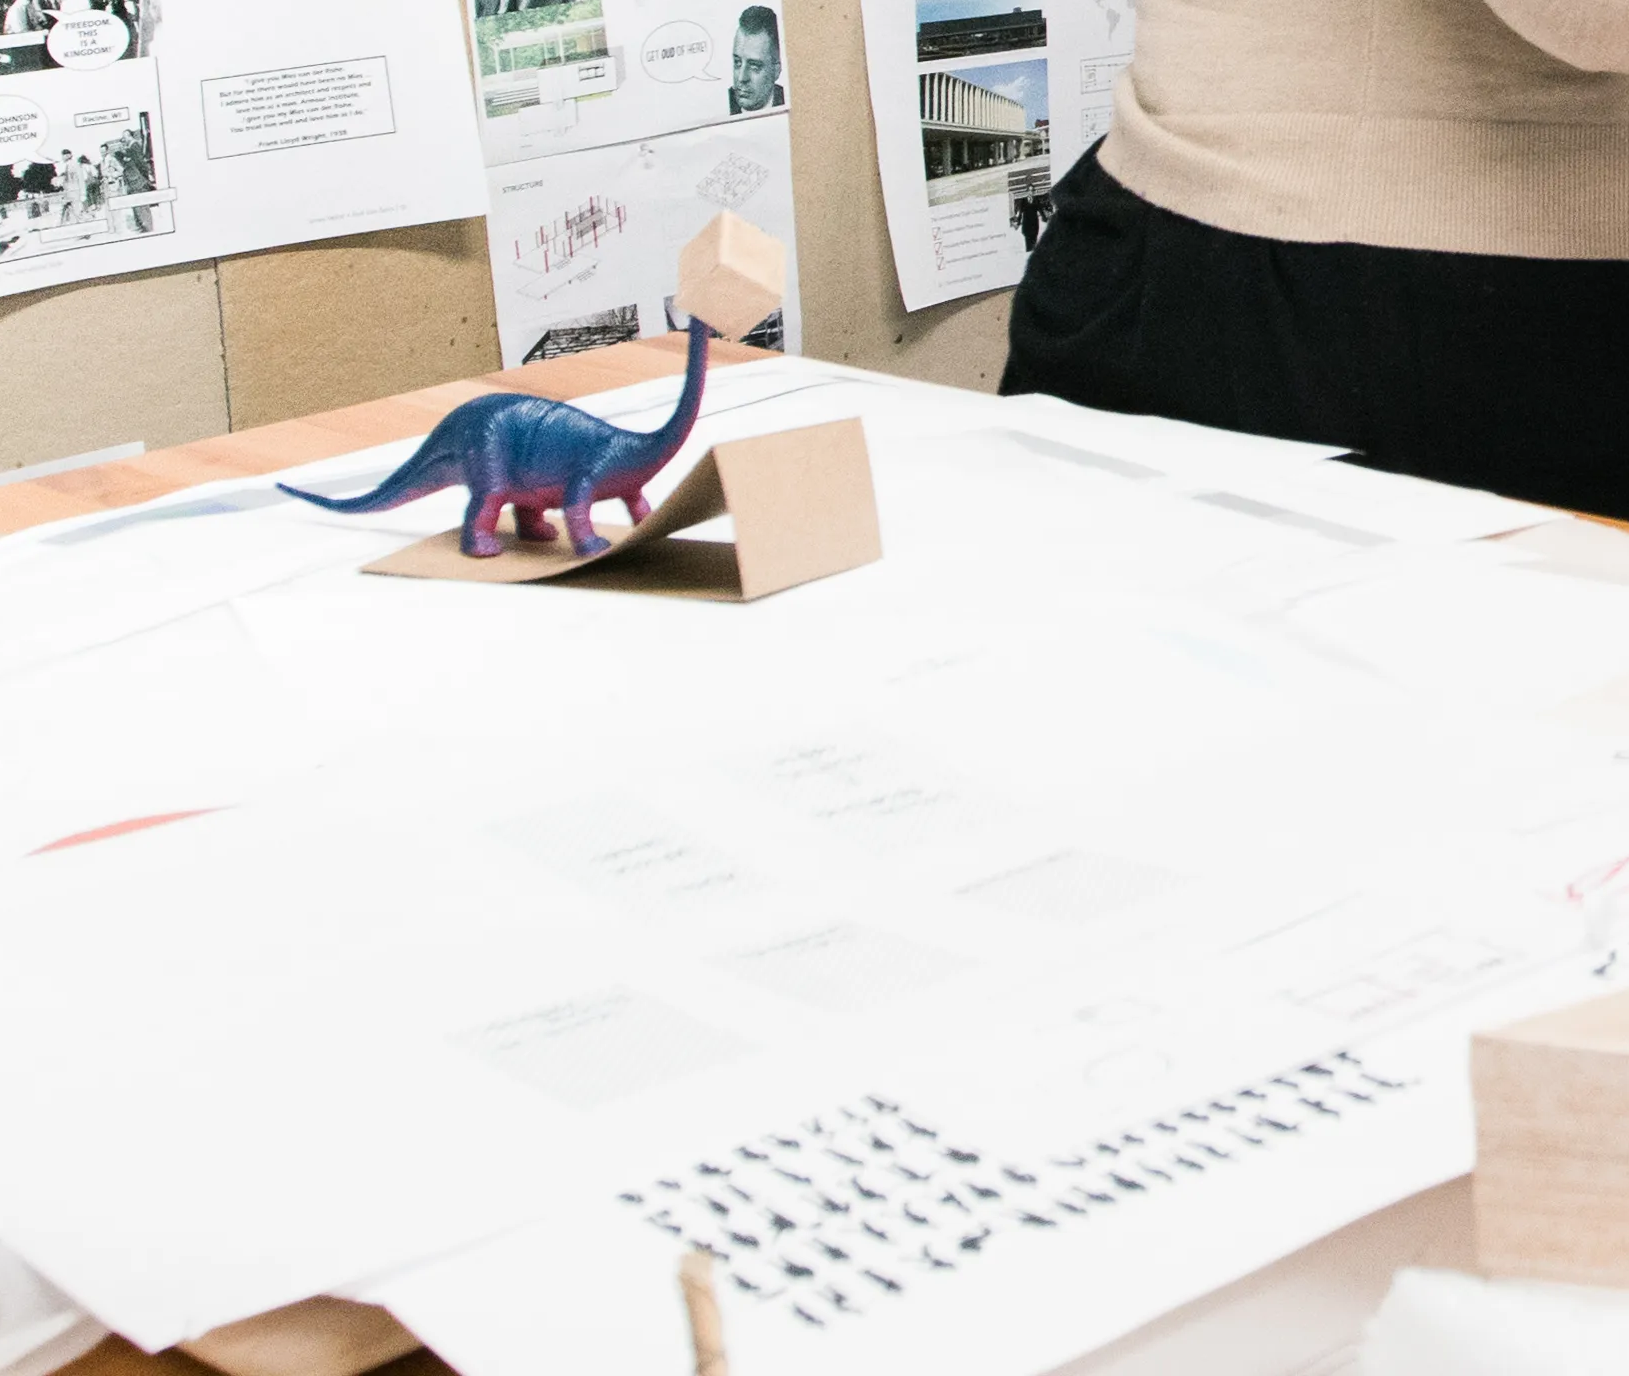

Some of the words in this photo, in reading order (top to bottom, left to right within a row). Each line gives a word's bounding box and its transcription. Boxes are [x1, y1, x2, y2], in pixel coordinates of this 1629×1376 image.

[77, 29, 98, 38] THIS
[645, 48, 660, 63] GET
[676, 44, 686, 58] OF
[502, 179, 543, 194] STRUCTURE
